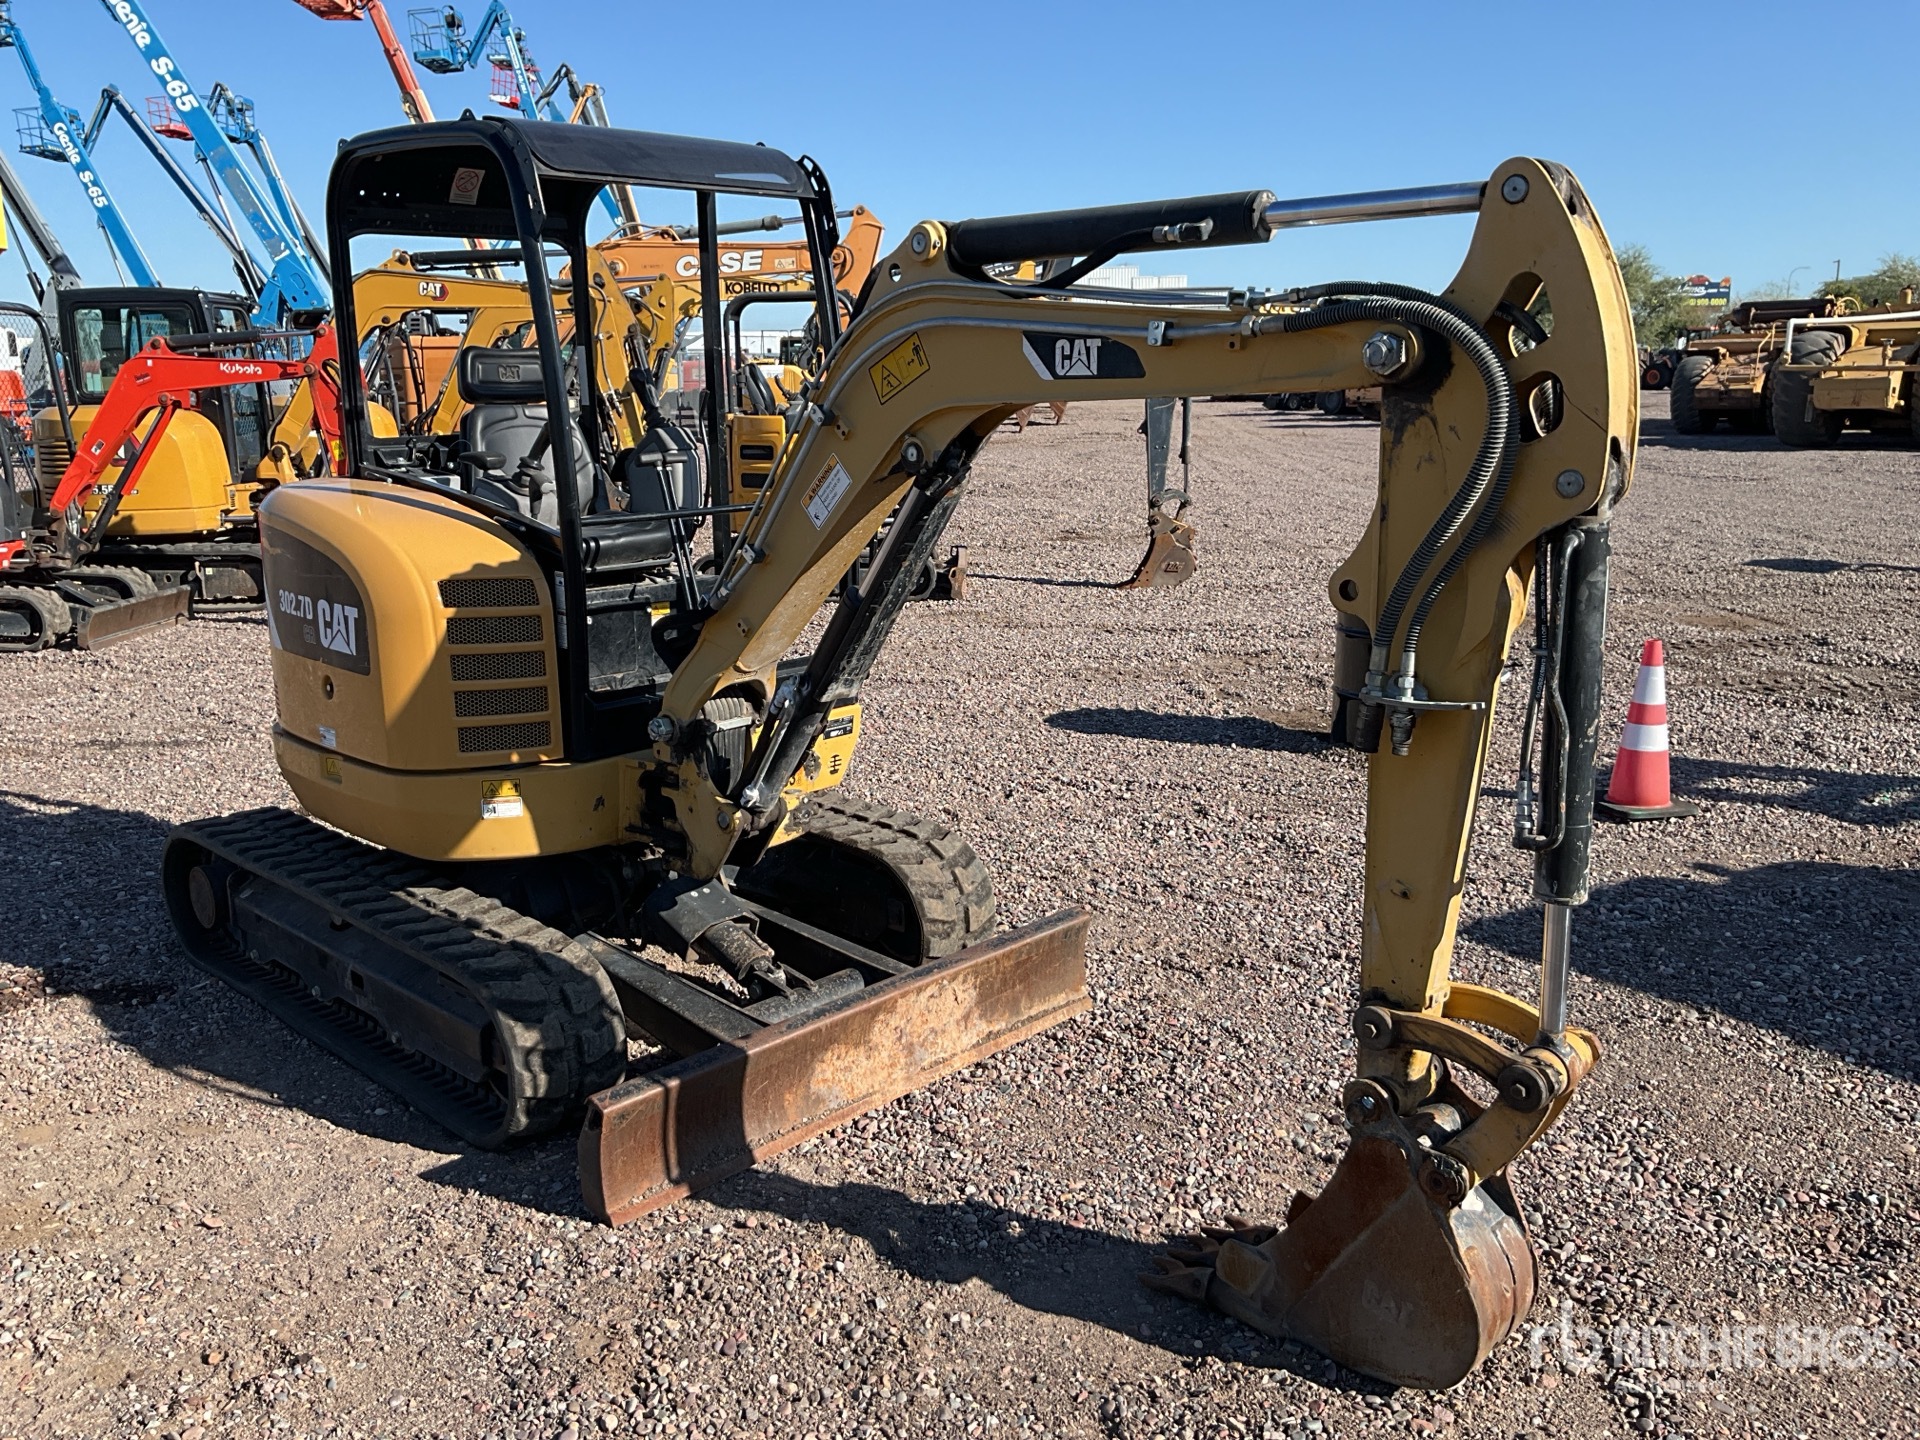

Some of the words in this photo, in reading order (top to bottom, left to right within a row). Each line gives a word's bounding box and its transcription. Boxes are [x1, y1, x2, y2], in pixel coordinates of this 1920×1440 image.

[150, 56, 200, 112] S-65
[53, 122, 81, 165] Genie
[79, 170, 109, 208] S-65
[675, 249, 764, 277] CSE
[419, 281, 442, 298] CAT
[219, 361, 262, 375] Kubota
[1055, 338, 1101, 376] CAT
[498, 364, 520, 381] CAT
[812, 464, 832, 494] WARNING
[279, 589, 313, 620] 302.7D
[316, 598, 358, 656] CAT
